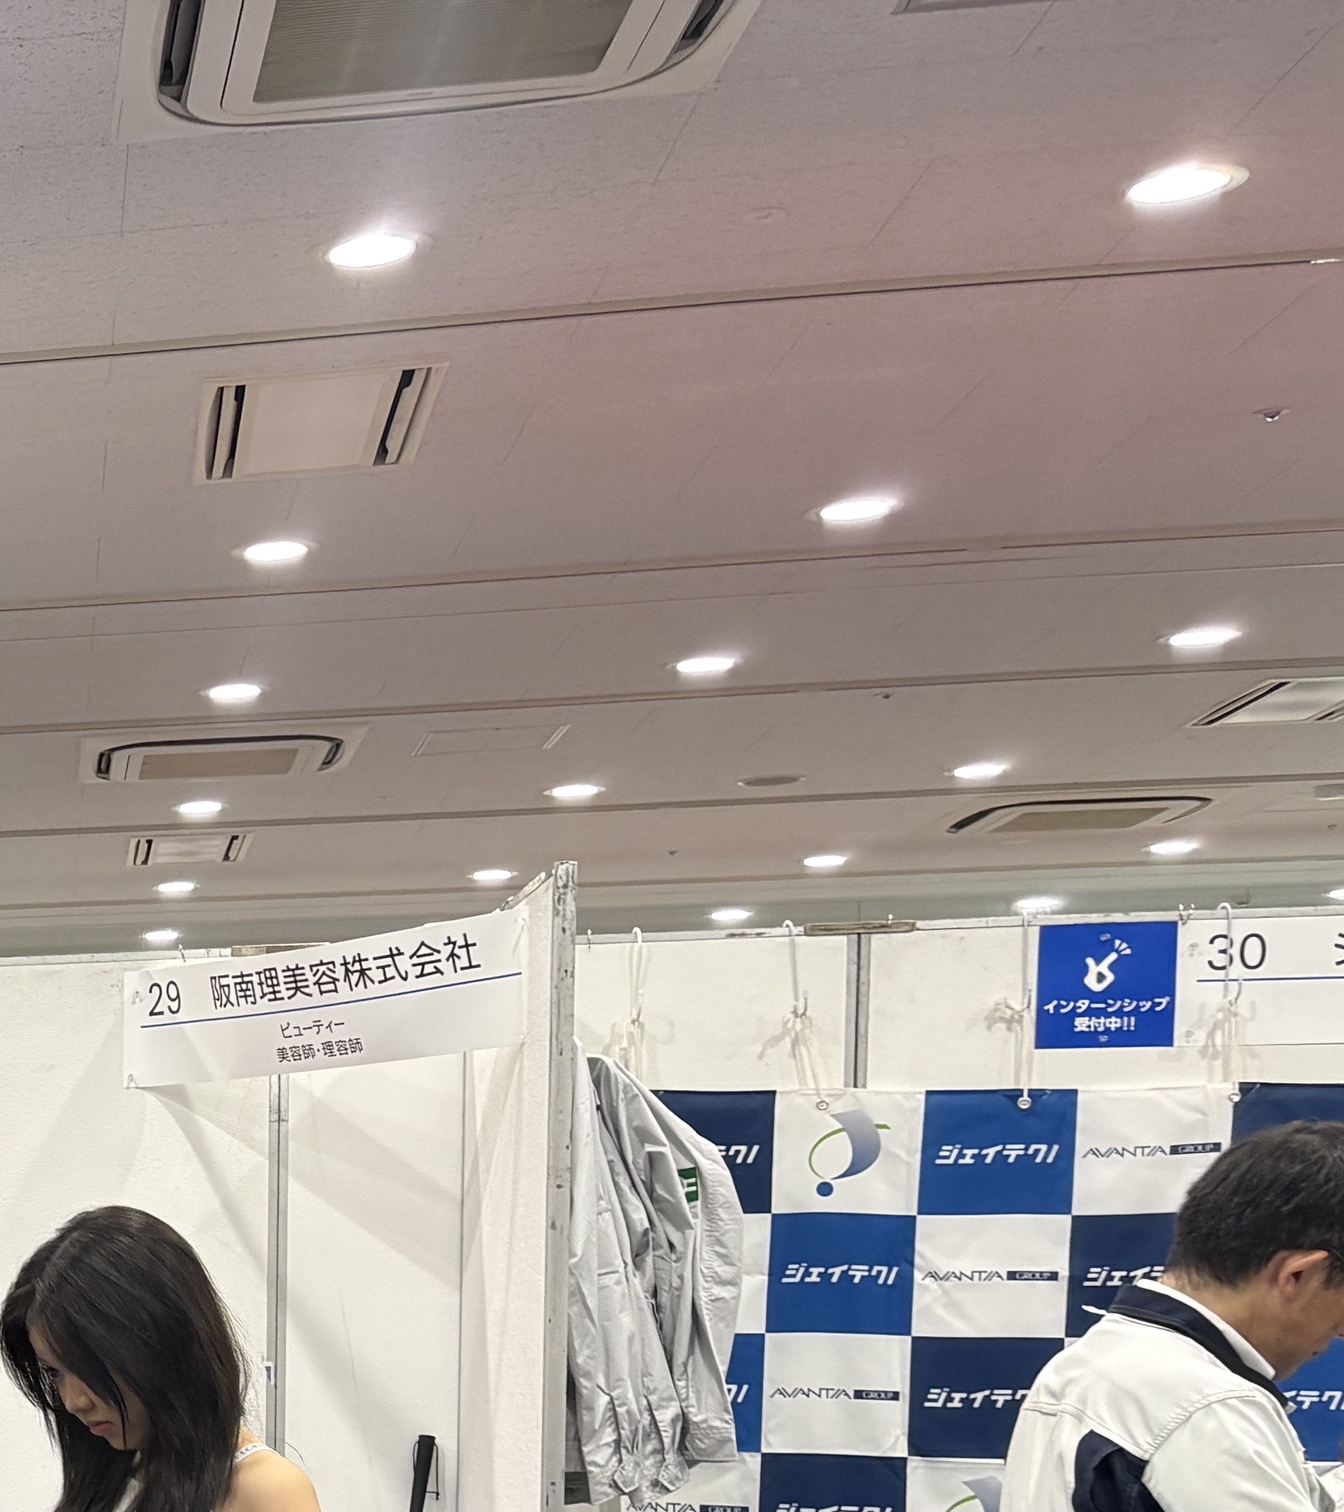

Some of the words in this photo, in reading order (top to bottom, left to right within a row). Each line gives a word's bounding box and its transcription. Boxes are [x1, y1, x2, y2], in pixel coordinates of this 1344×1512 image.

[1207, 932, 1267, 971] 30
[148, 980, 181, 1017] 29
[209, 932, 483, 1010] 阪南理美容株式会社
[1043, 996, 1171, 1014] インターンシップ
[279, 1019, 346, 1040] ビューティー
[1073, 1016, 1136, 1032] 受付中!!
[276, 1037, 364, 1063] 美容師・理容師
[1081, 1145, 1169, 1159] AVANTIA
[921, 1270, 1005, 1282] AVANTIA
[769, 1386, 853, 1400] AVANTIA
